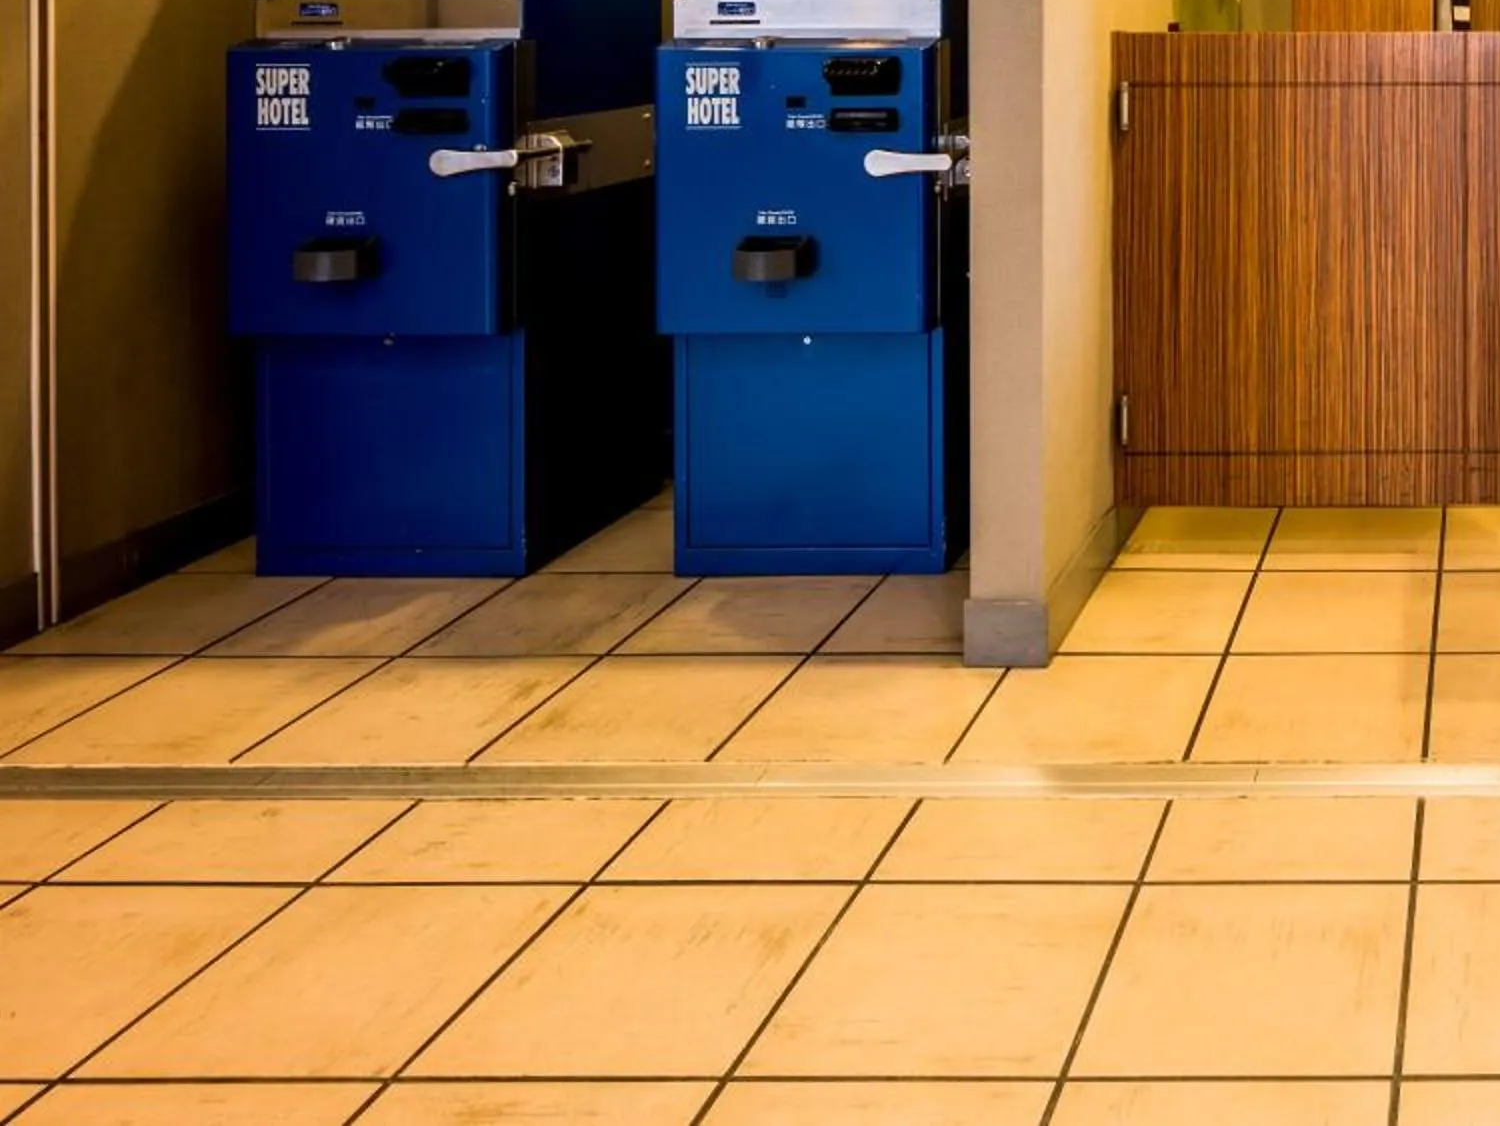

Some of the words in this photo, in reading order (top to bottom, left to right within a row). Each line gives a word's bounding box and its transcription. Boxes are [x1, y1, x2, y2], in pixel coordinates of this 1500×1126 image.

[255, 67, 311, 95] SUPER
[684, 67, 740, 95] SUPER
[257, 97, 311, 125] HOTEL
[686, 97, 740, 125] HOTEL
